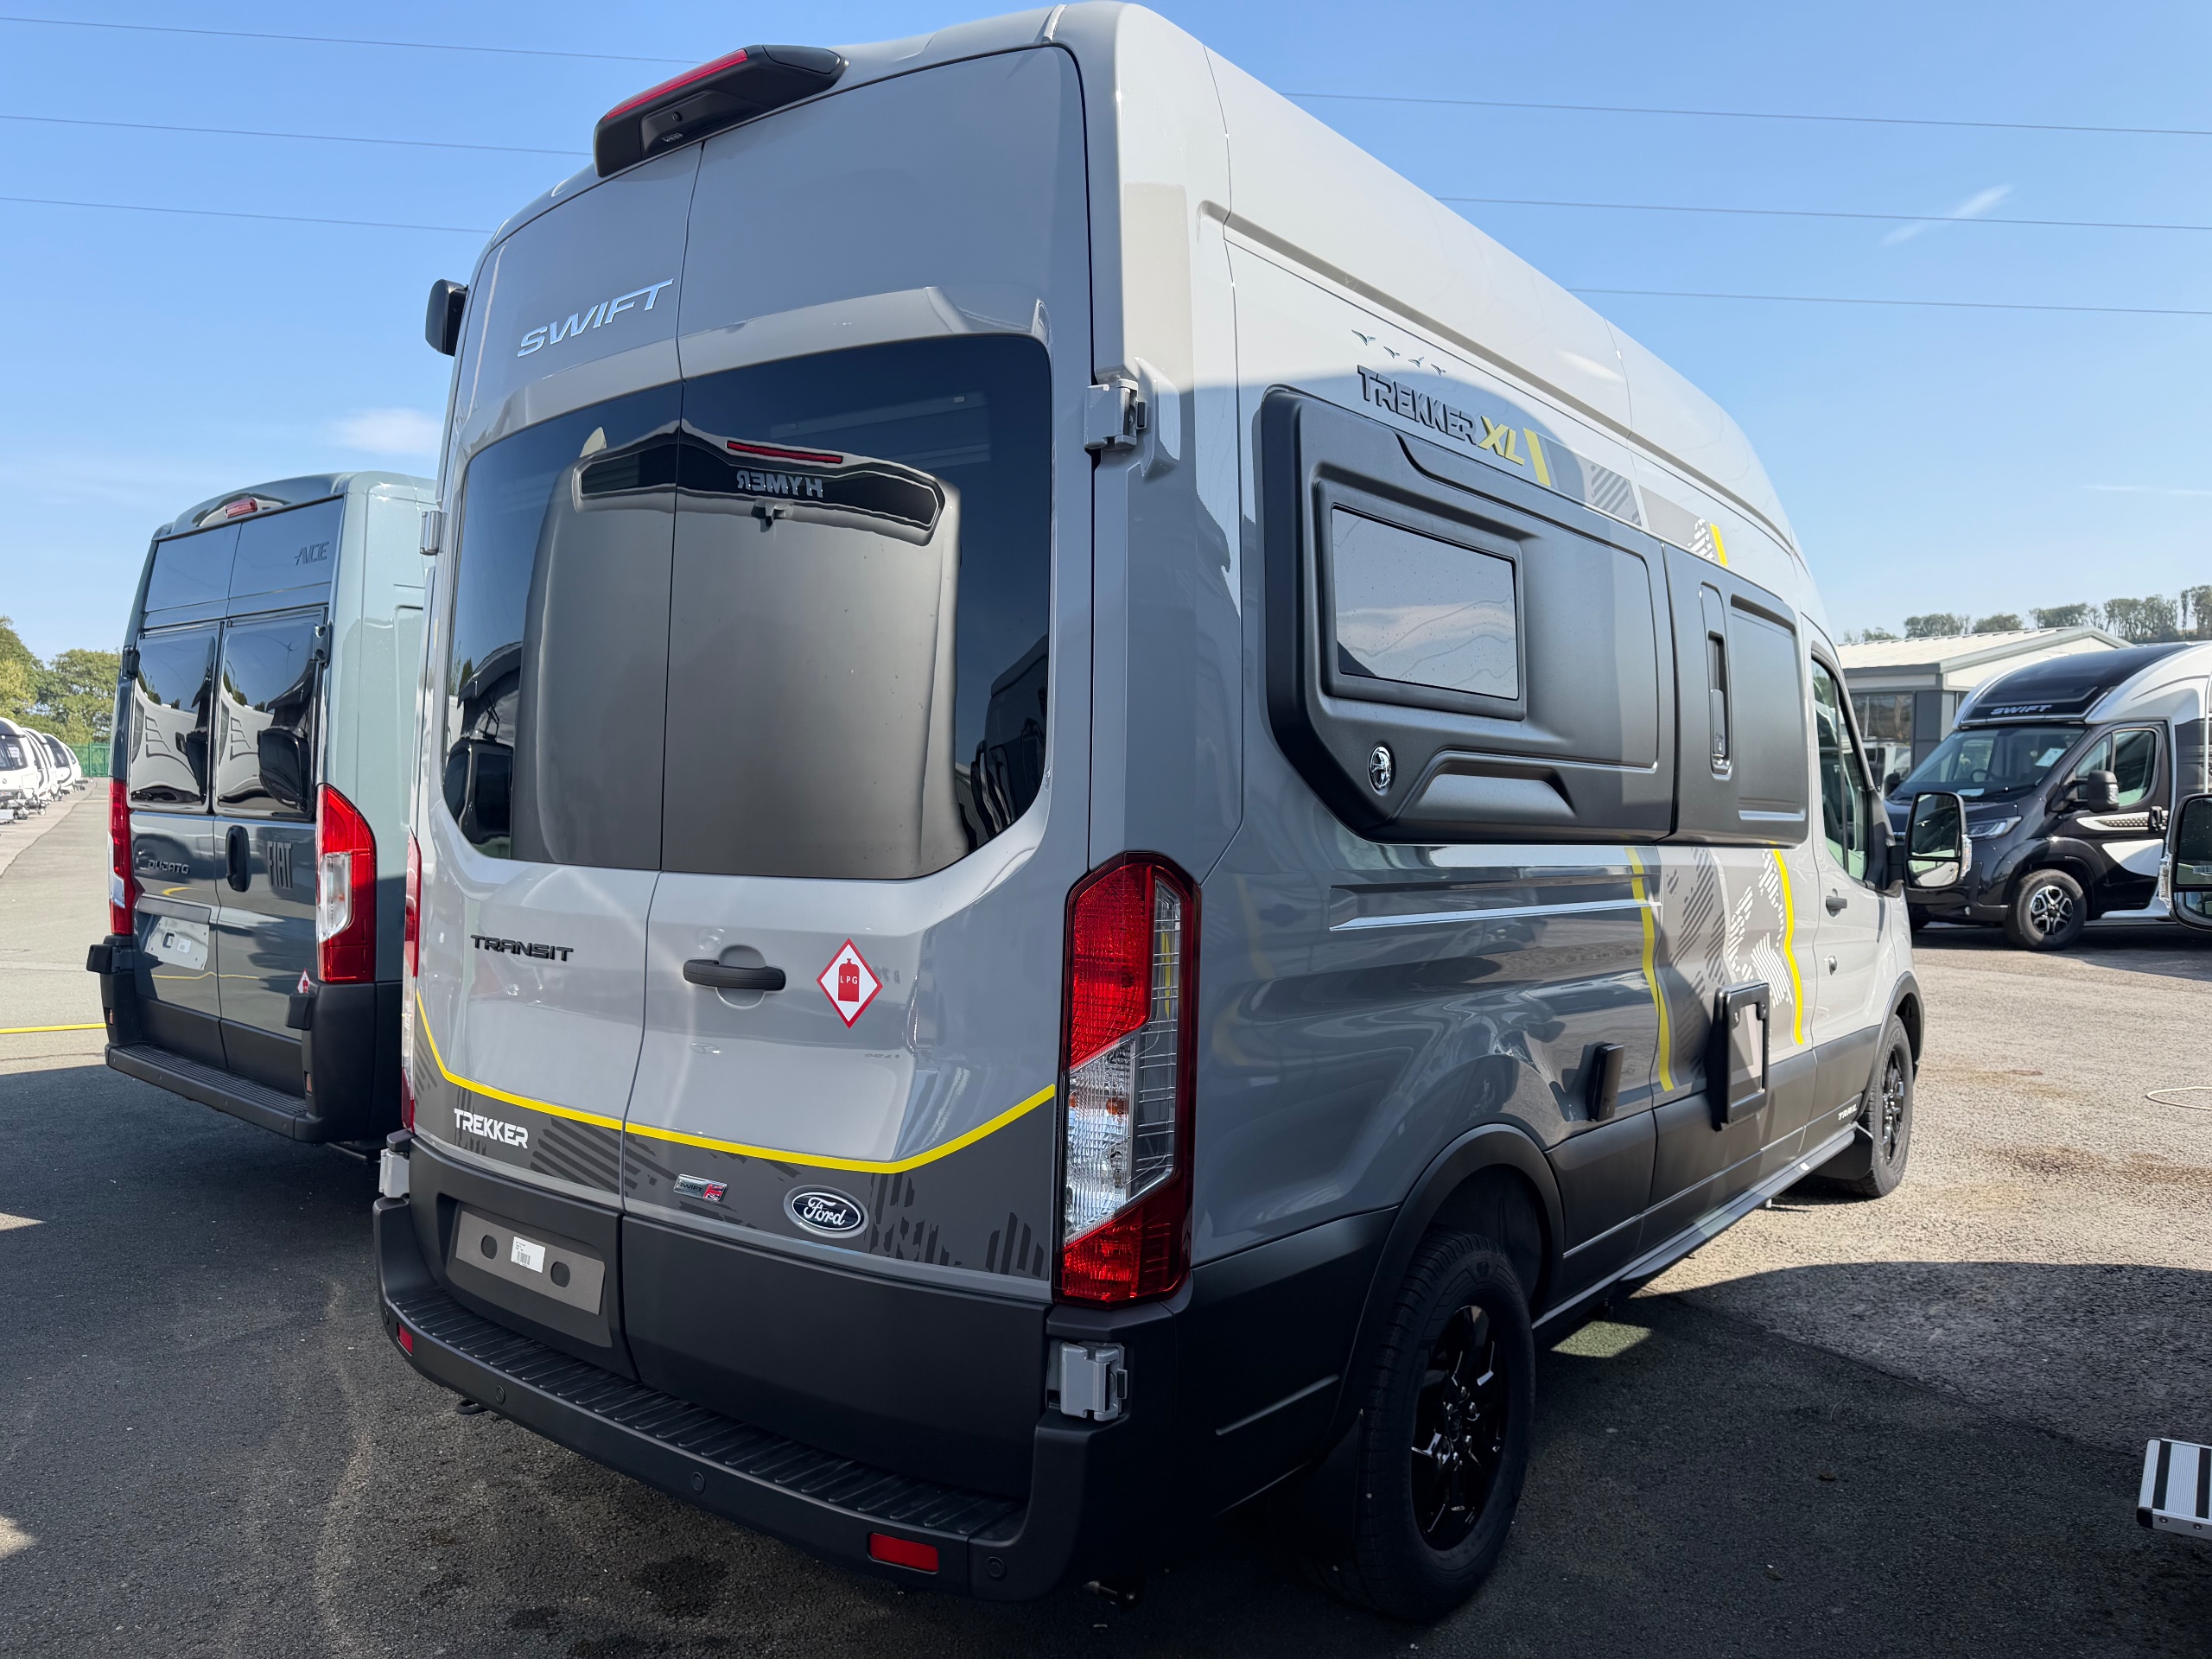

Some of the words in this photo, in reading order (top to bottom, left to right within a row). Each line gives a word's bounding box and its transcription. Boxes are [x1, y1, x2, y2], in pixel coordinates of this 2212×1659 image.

[517, 278, 674, 358] SWIFT
[1357, 364, 1477, 446] TREKKER
[1478, 415, 1525, 466] XL
[294, 541, 330, 566] ACE
[1990, 704, 2053, 715] SWIFT
[267, 841, 293, 889] FIAT
[470, 934, 575, 963] TRANSIT
[840, 975, 858, 985] LPG
[454, 1107, 529, 1149] TREKKER
[677, 1180, 703, 1192] SWIFT
[803, 1196, 847, 1226] Ford
